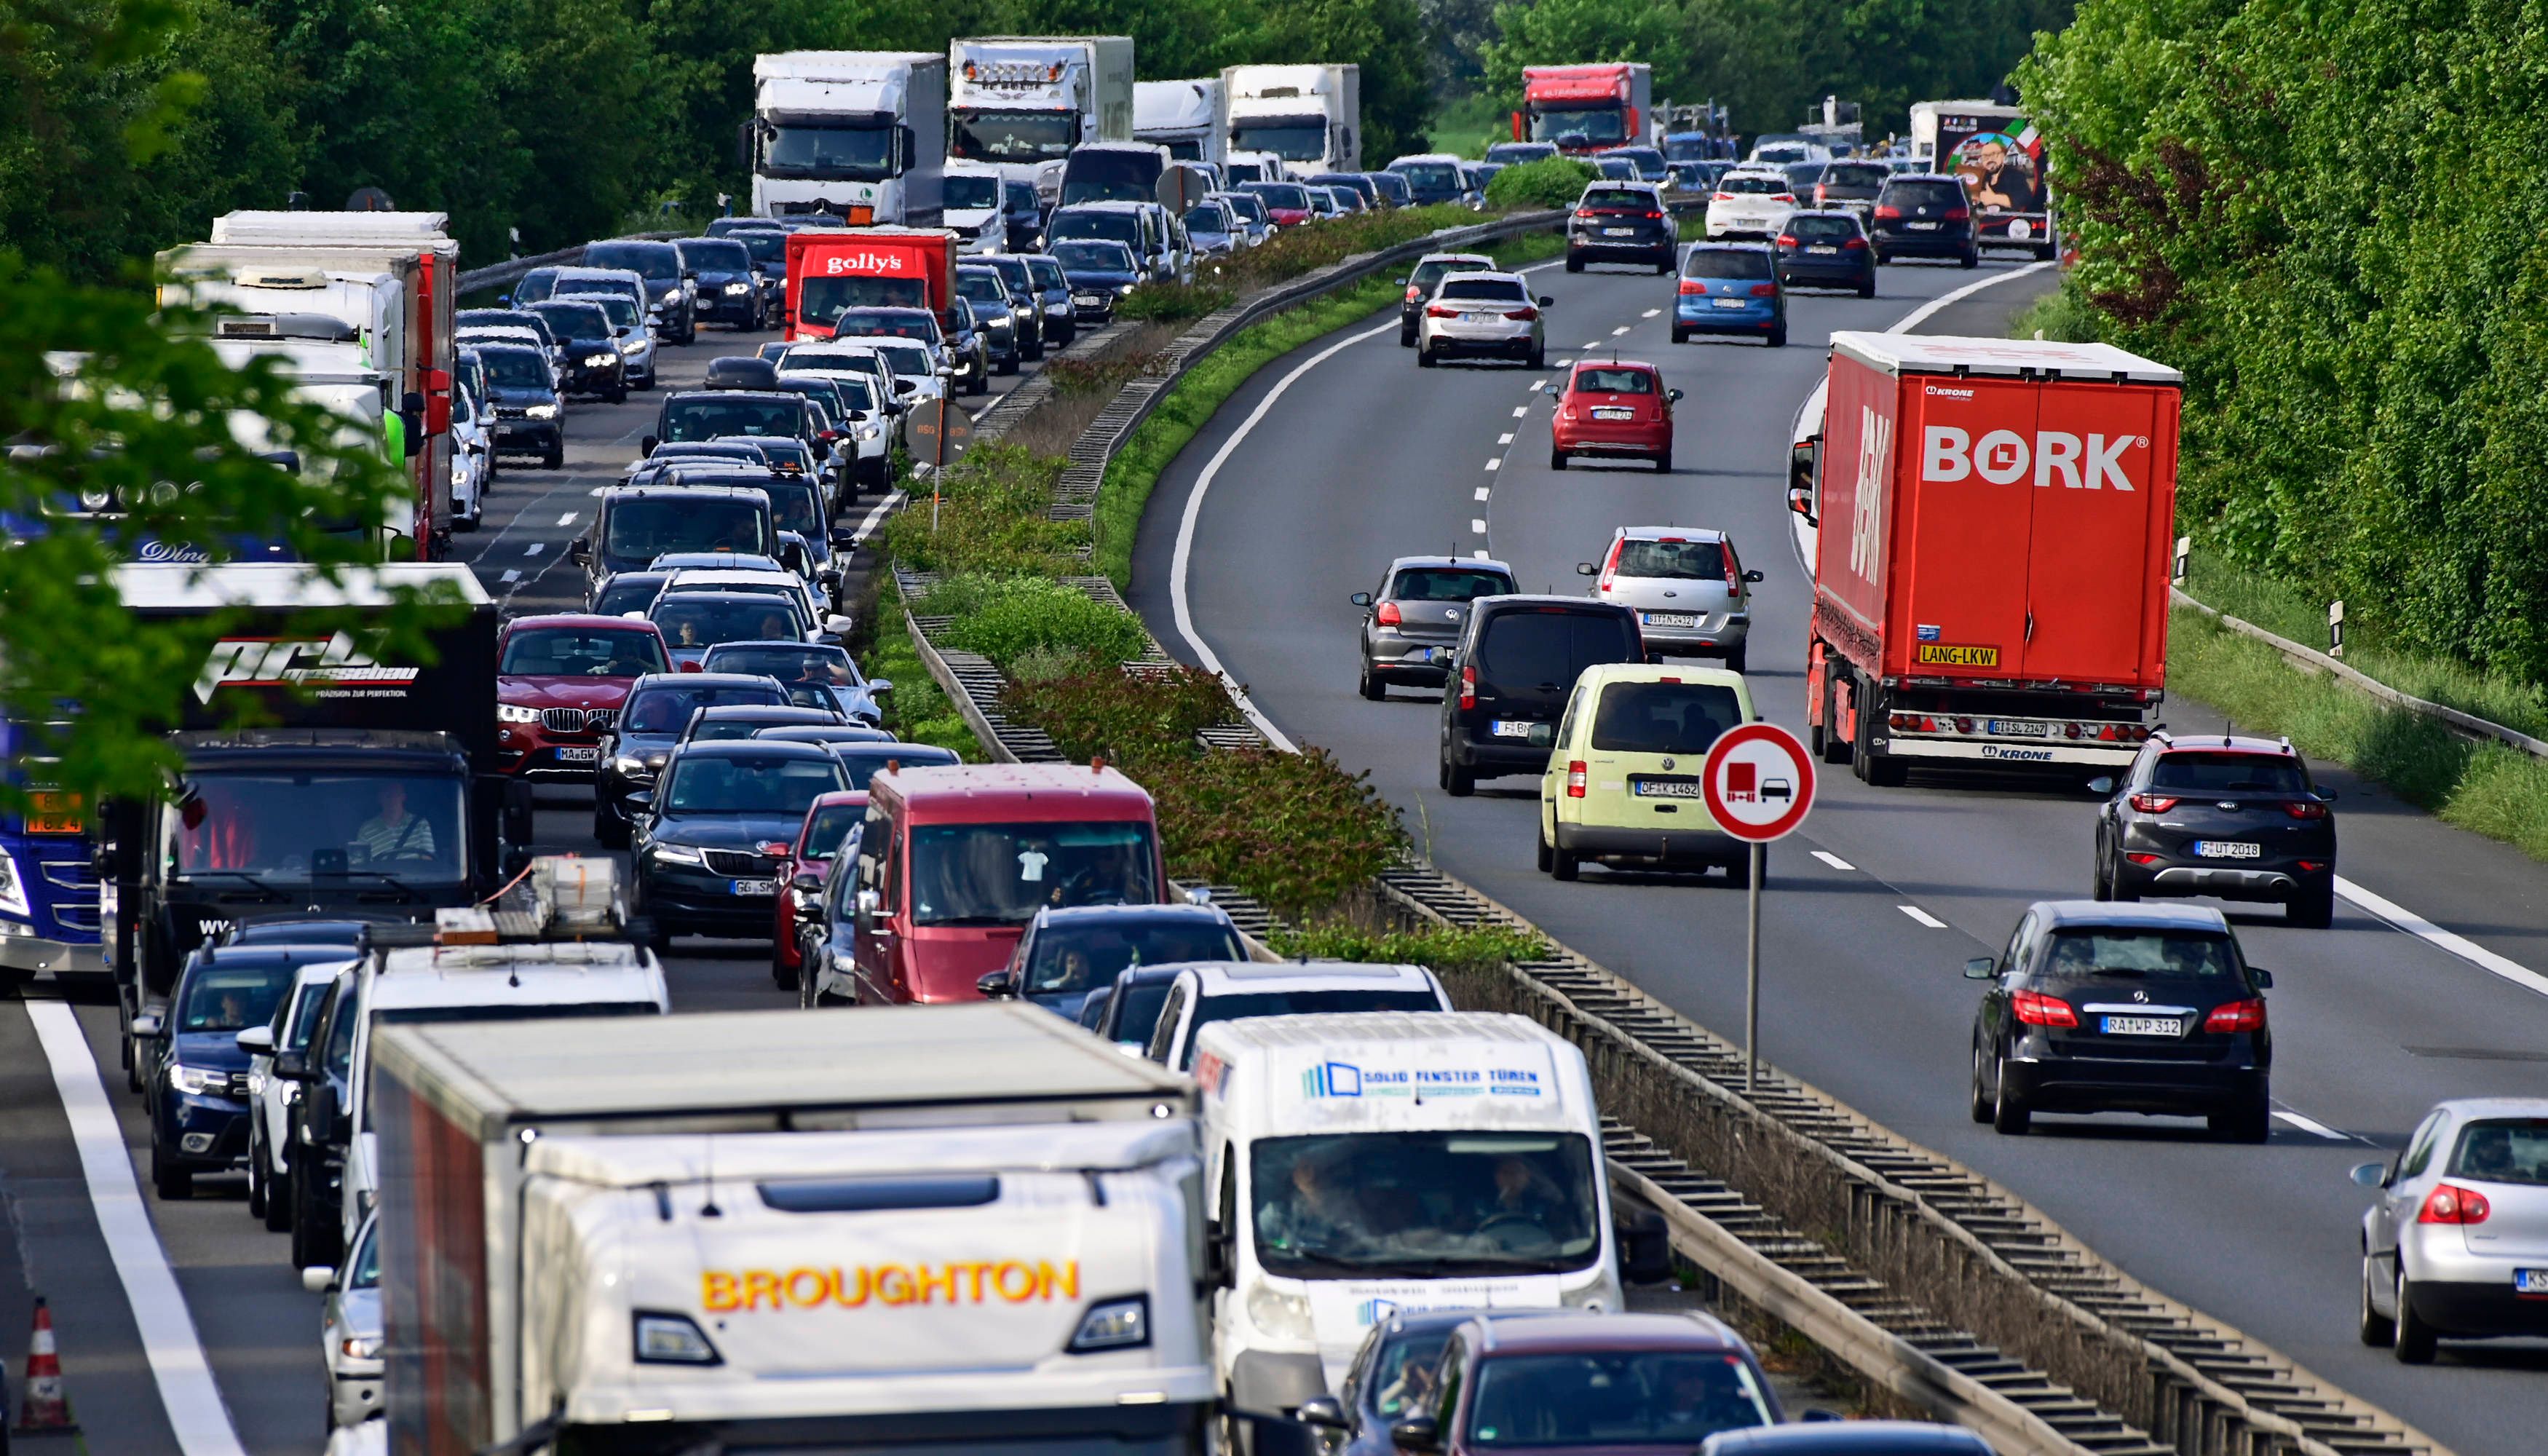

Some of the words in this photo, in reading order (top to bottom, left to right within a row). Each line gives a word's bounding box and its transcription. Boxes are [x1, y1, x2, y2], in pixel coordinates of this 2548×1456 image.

[827, 253, 901, 274] golly's
[1937, 388, 1974, 397] KRONE
[1923, 646, 1994, 665] LANG-LKW
[1505, 723, 1511, 732] F
[1995, 722, 2004, 732] GI
[2011, 724, 2022, 733] SL
[2025, 724, 2045, 735] 2147
[561, 749, 574, 759] MA
[581, 749, 594, 759] GW
[1999, 749, 2052, 760] KRONE
[1642, 782, 1655, 793] OF
[1663, 784, 1669, 794] K
[1671, 785, 1697, 796] 1462
[2201, 842, 2209, 852] F
[2216, 844, 2228, 854] UT
[2231, 844, 2258, 855] 2018
[737, 882, 751, 893] GG
[759, 882, 774, 893] SM
[2109, 1019, 2126, 1032] RA
[2135, 1019, 2152, 1032] WP
[2155, 1021, 2179, 1034] 312
[1364, 1072, 1409, 1083] SOLID
[1416, 1071, 1481, 1083] FENSTER
[1489, 1069, 1538, 1083] TÜREN
[701, 1259, 1080, 1311] BROUGHTON
